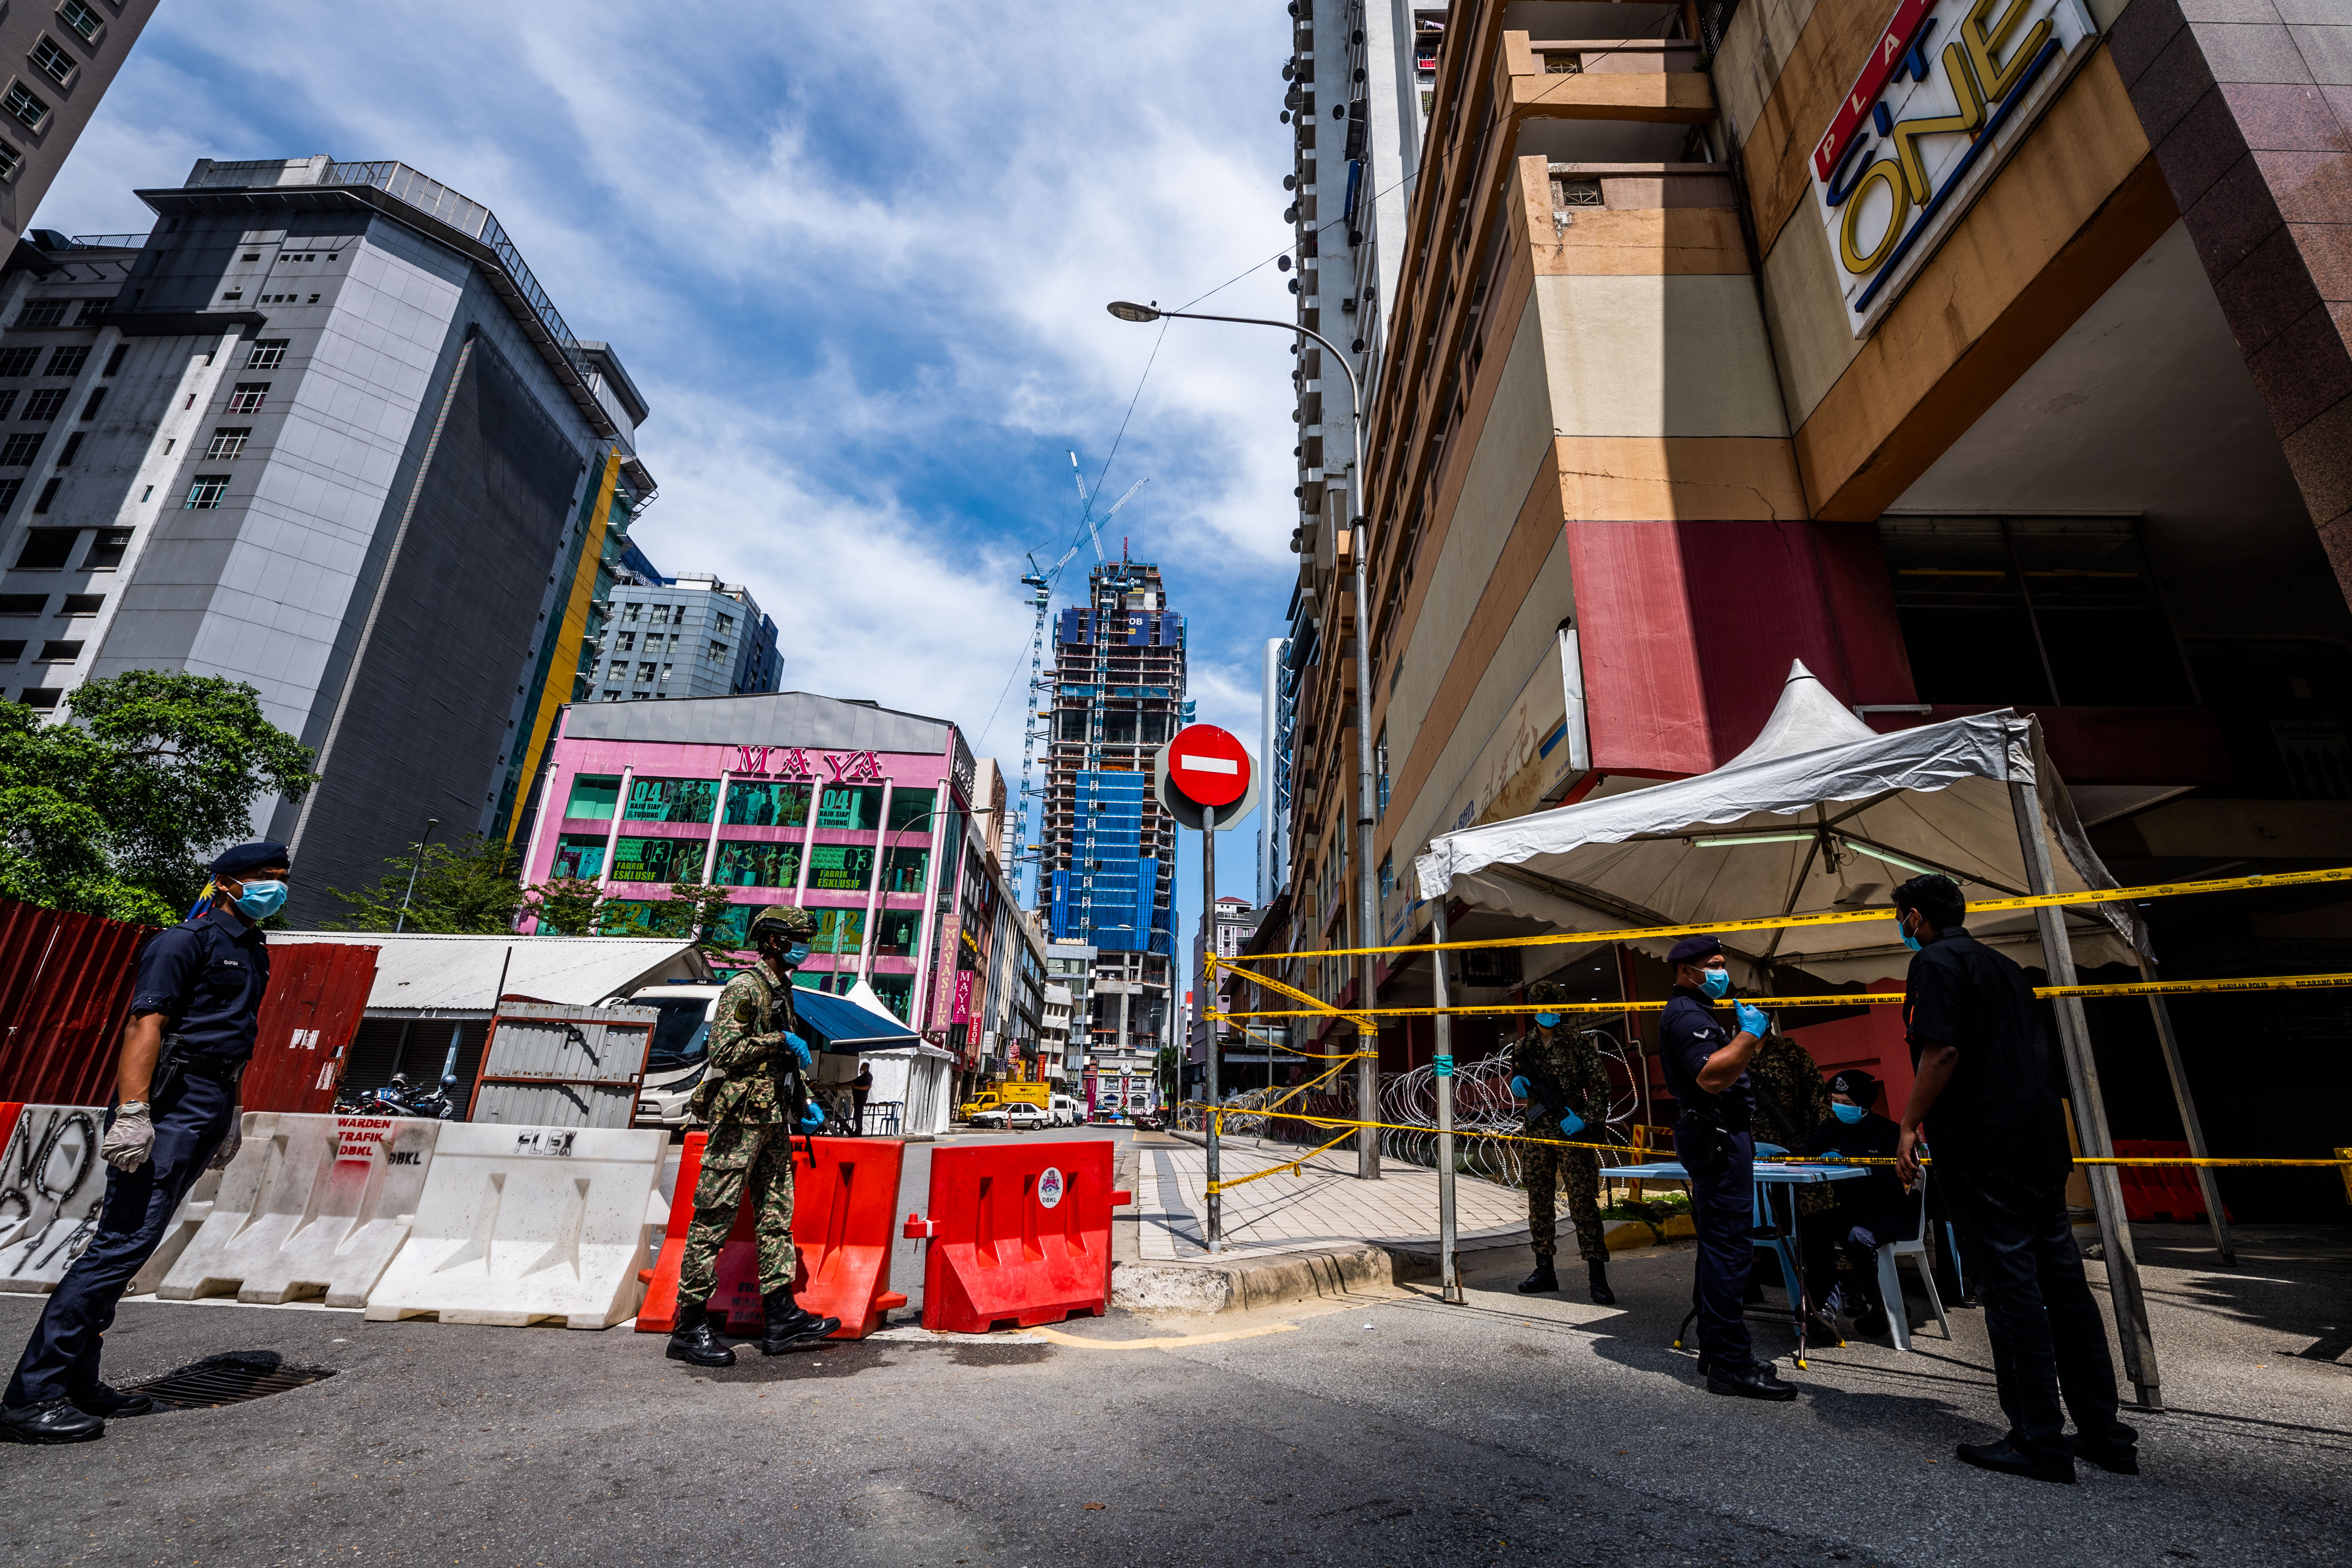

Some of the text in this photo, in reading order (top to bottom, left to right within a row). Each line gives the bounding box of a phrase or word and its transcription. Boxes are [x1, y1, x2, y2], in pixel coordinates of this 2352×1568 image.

[1822, 0, 1927, 164] PLA
[1826, 16, 1939, 208] CIT
[1839, 0, 2053, 275] ONE
[734, 744, 884, 782] MAYA
[634, 782, 662, 802] 04
[823, 790, 849, 810] 04
[640, 841, 671, 862] 03
[844, 849, 872, 870] 03
[613, 871, 656, 880] ESKLUSIF
[817, 878, 860, 888] ESKLUSIF
[821, 911, 858, 933] 02
[816, 934, 850, 943] FABRK
[936, 928, 957, 1026] MAYASILK
[2296, 979, 2332, 987] DILARANG
[957, 972, 970, 1014] MAYA
[338, 1118, 391, 1129] WARDEN
[338, 1131, 384, 1142] TRAFIK
[514, 1129, 577, 1156] FLEX
[339, 1146, 373, 1156] DBKL
